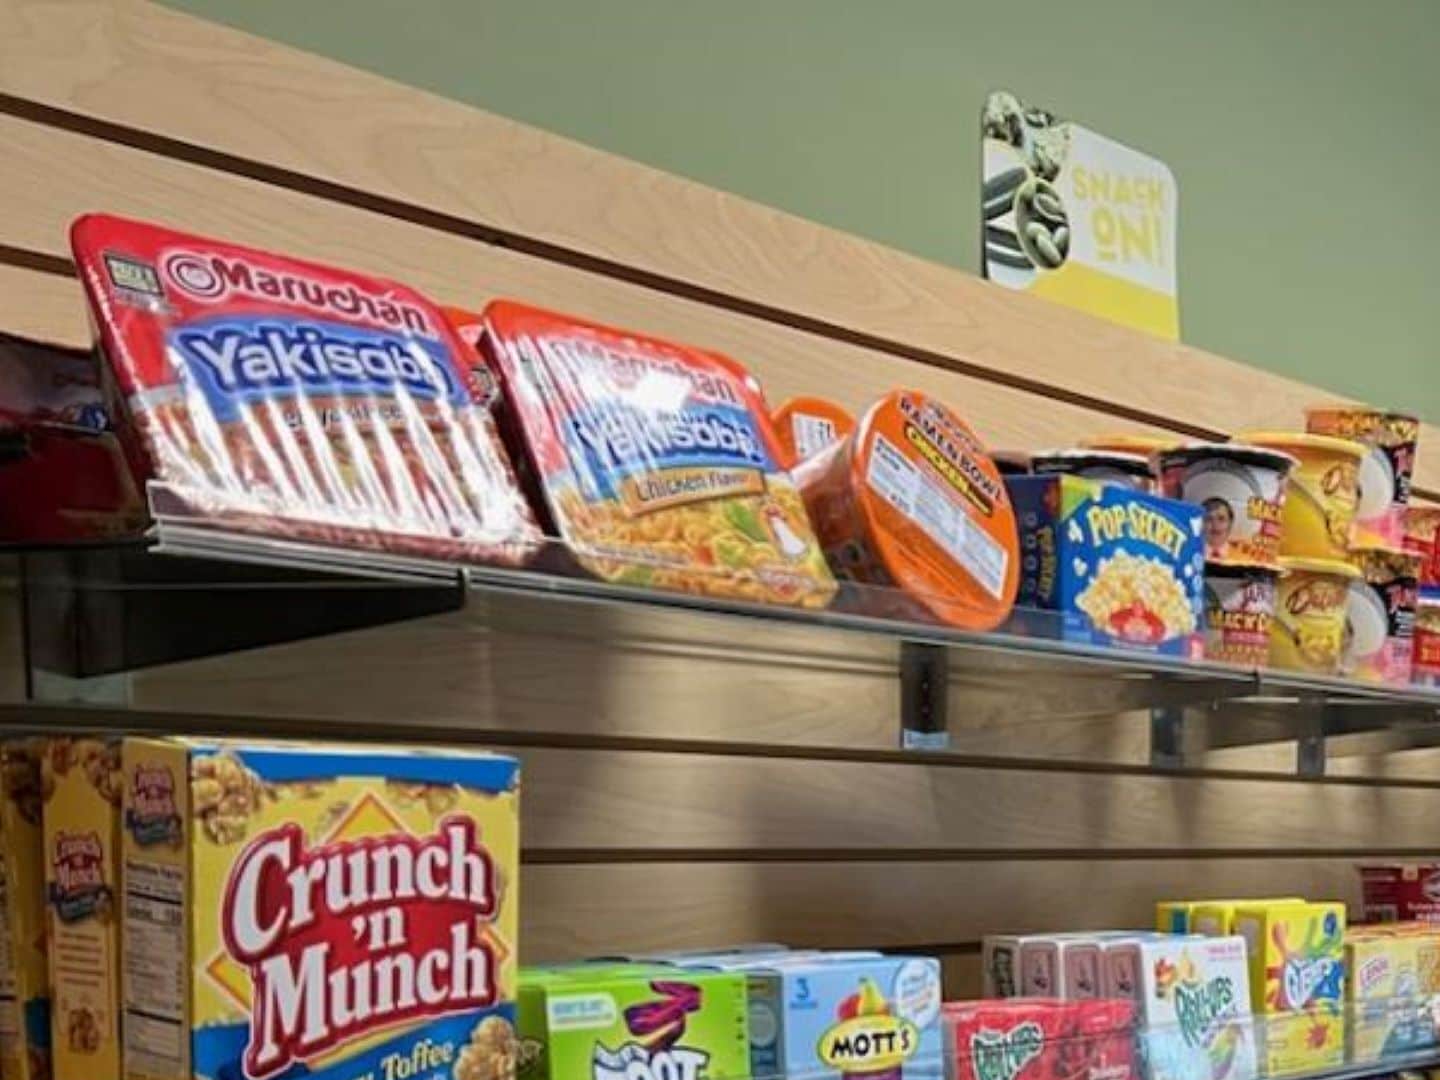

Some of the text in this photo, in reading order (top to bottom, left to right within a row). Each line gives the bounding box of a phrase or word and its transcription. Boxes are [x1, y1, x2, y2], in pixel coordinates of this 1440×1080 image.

[212, 256, 430, 334] Maruchan
[231, 822, 489, 953] Crunch
[256, 924, 491, 1062] Munch
[795, 976, 811, 1001] 3
